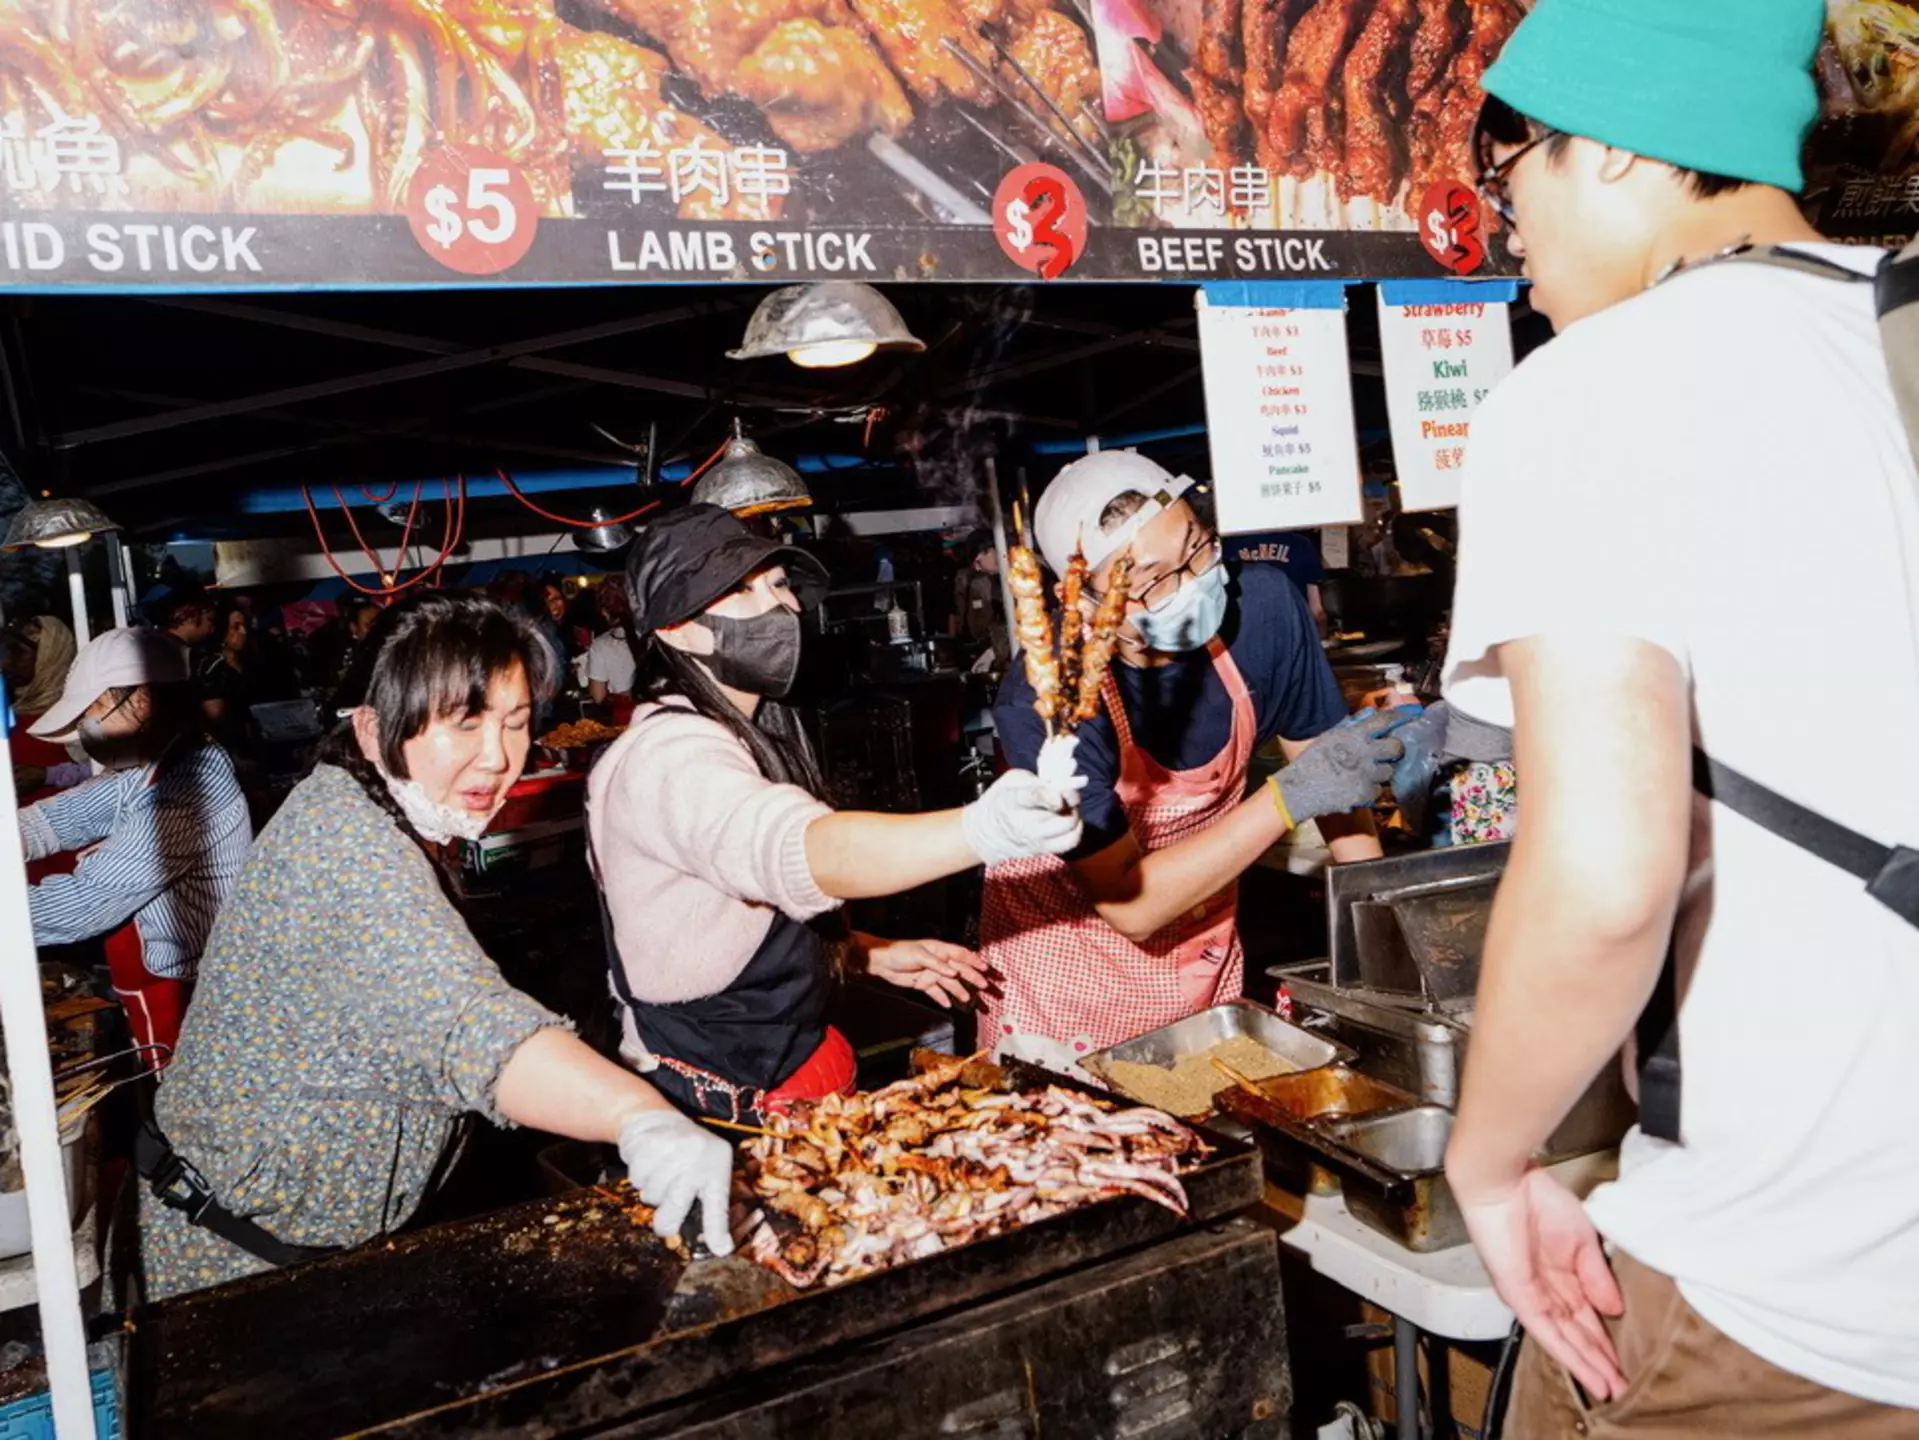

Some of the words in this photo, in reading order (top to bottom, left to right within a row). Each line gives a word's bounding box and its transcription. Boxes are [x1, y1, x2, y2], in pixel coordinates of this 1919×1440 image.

[602, 142, 791, 206] 羊肉串
[1135, 159, 1271, 216] 牛肉串
[423, 168, 517, 249] $5
[86, 223, 262, 272] STICK
[607, 230, 737, 271] LAMB
[751, 230, 876, 271] STICK
[1137, 237, 1223, 271] BEEF
[1235, 238, 1330, 272] STICK
[1403, 302, 1485, 318] Strawberry
[1455, 328, 1474, 347] $5
[1433, 359, 1468, 379] Kiwi
[1262, 386, 1300, 396] Chicken
[1271, 424, 1299, 437] Squid
[1268, 464, 1310, 475] Pancake
